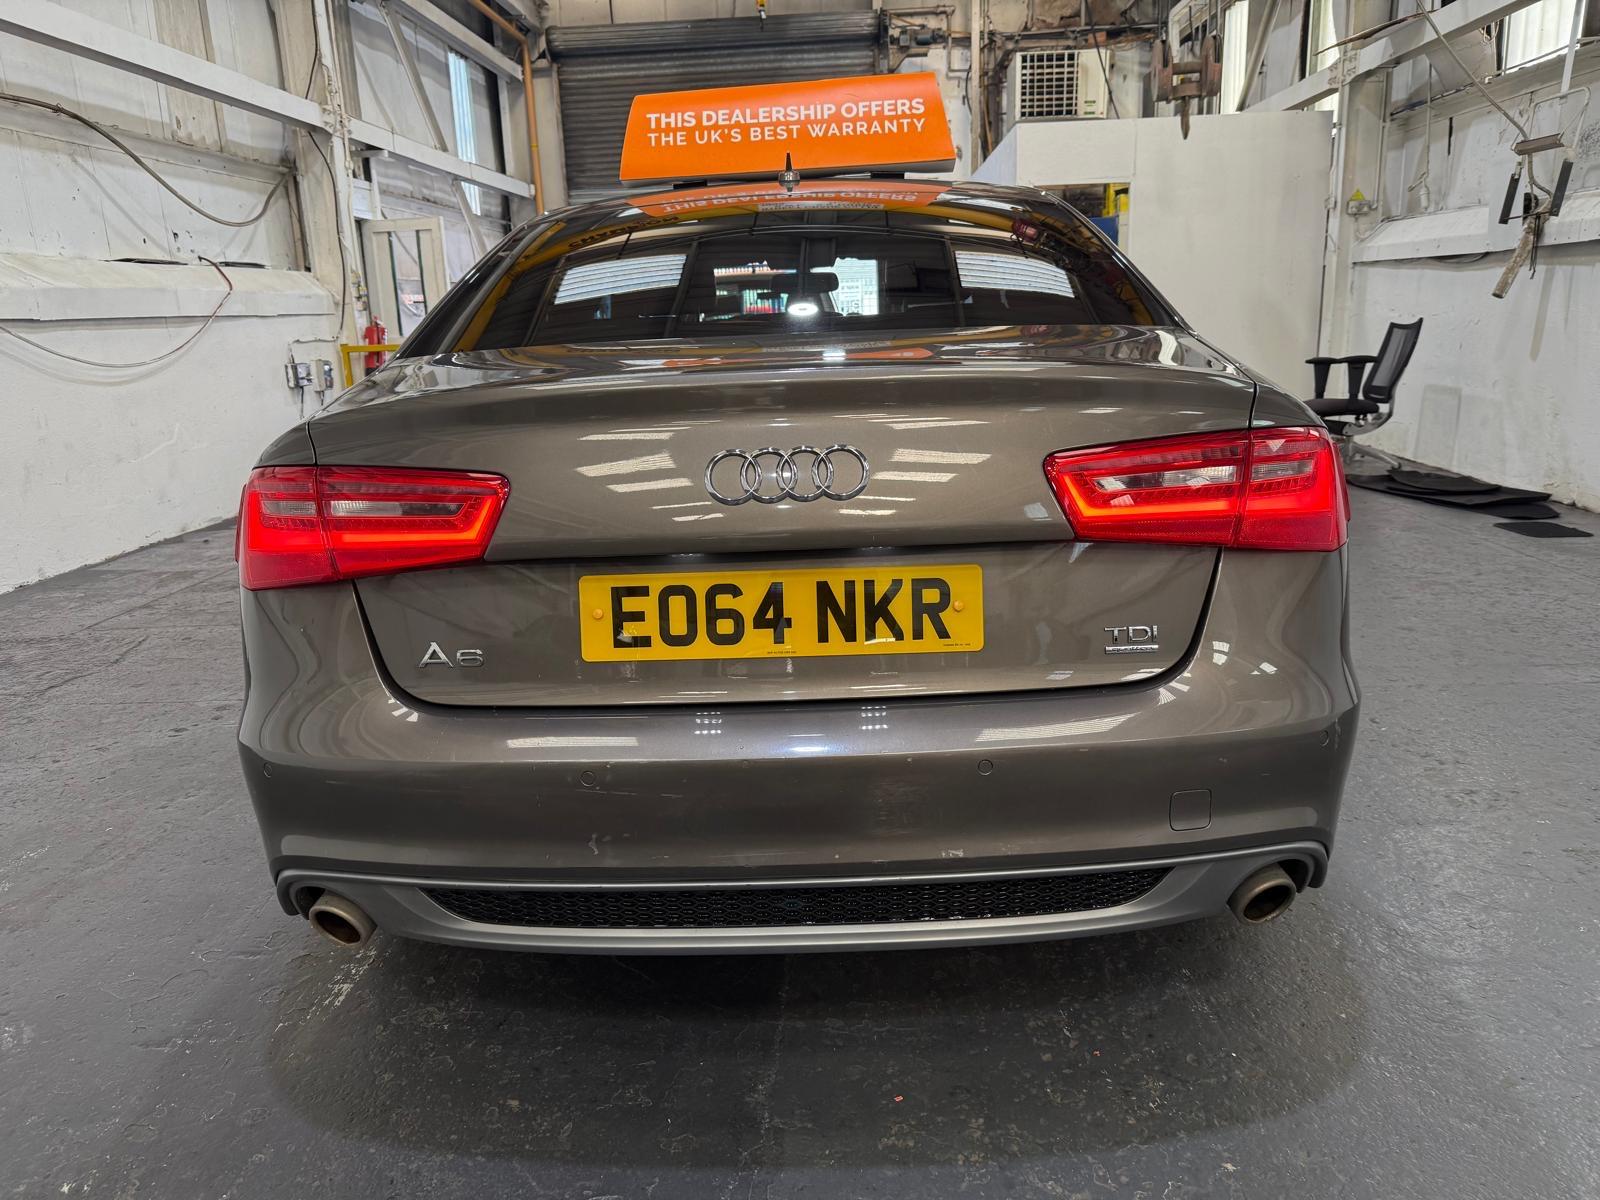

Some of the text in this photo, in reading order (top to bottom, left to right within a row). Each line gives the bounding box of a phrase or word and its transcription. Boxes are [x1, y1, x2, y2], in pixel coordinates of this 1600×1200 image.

[646, 98, 925, 129] THIS DEALERSHIP OFFERS
[647, 118, 926, 147] THE UK'S BEST WARRANTY
[611, 578, 952, 649] EO64 NKR
[1104, 625, 1158, 643] TDI
[419, 642, 484, 668] A6
